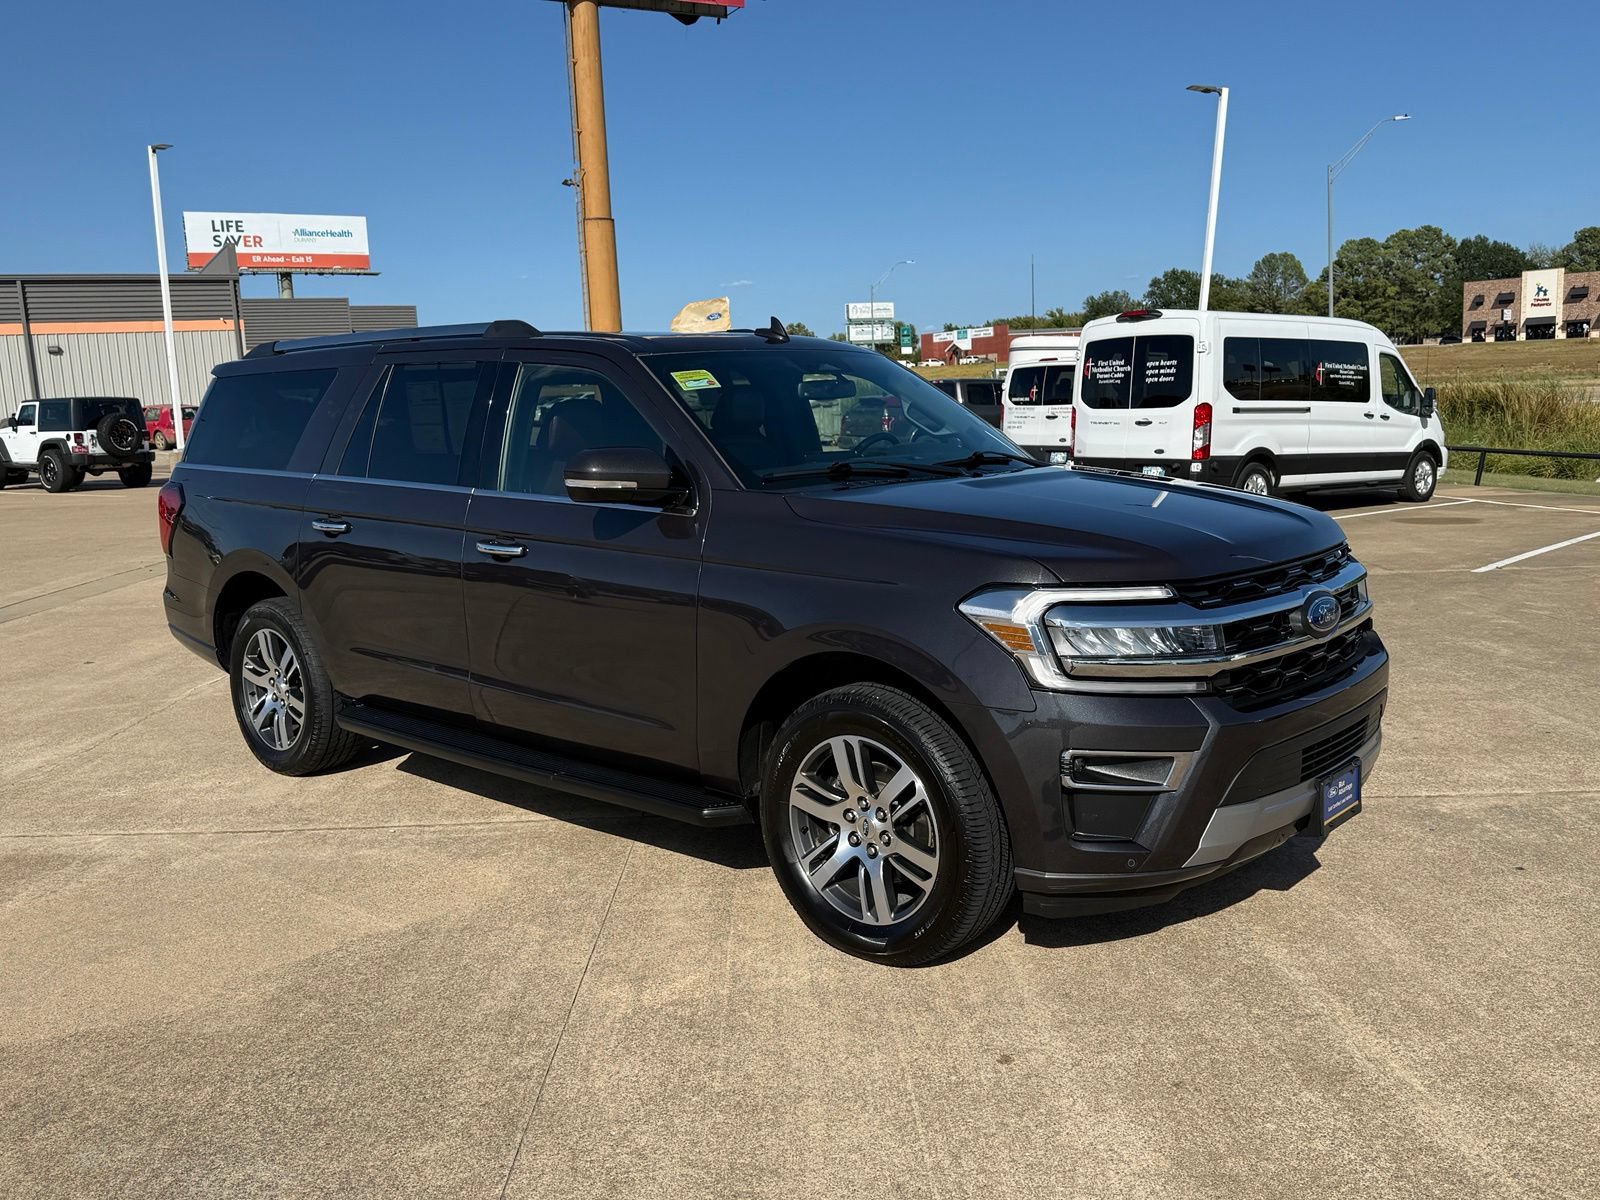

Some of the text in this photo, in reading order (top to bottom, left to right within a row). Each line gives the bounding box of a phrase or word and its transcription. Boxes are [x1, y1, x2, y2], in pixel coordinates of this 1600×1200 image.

[211, 220, 244, 232] LIFE
[294, 228, 353, 238] AllianceHealth
[213, 235, 263, 248] SAVER
[1318, 603, 1338, 624] Ford
